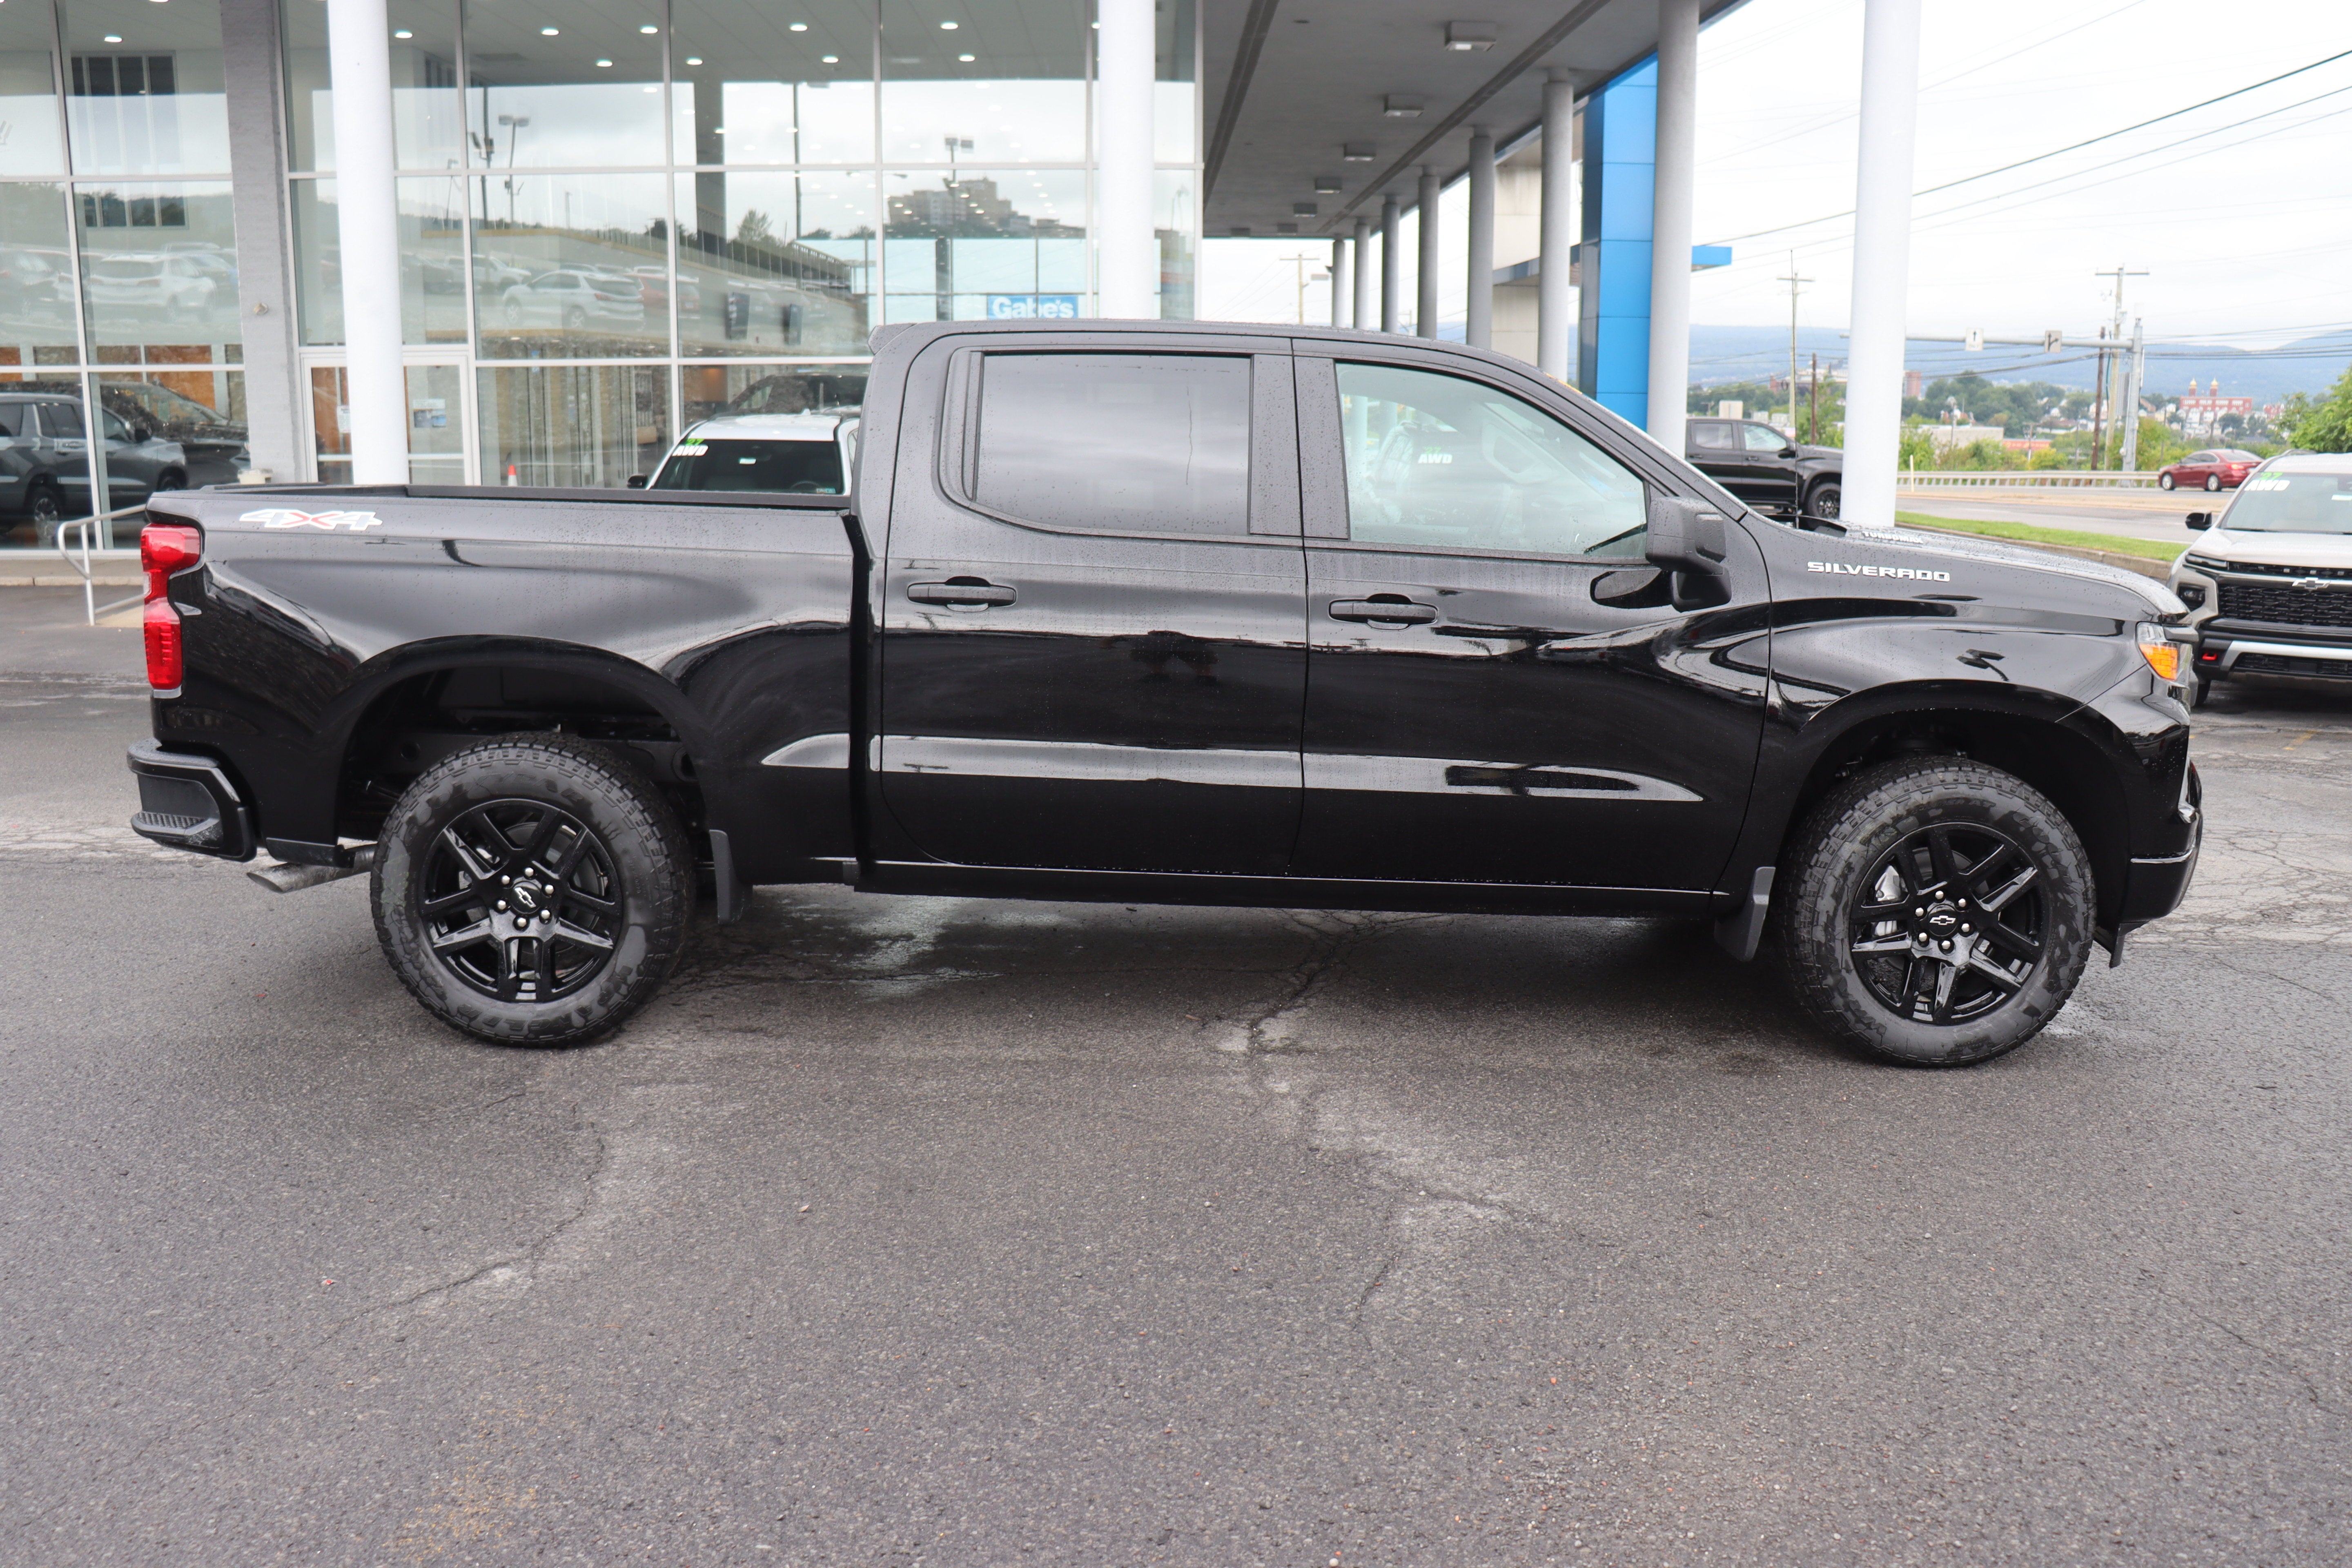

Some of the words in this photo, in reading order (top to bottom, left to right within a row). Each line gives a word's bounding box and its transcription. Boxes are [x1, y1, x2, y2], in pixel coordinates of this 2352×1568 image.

[993, 296, 1075, 319] Gabe's
[672, 444, 709, 456] AWD
[1418, 454, 1452, 464] AWD
[2244, 479, 2290, 491] AWD
[1862, 531, 1924, 544] TURBOMAX
[1807, 561, 1950, 582] SILVERADO
